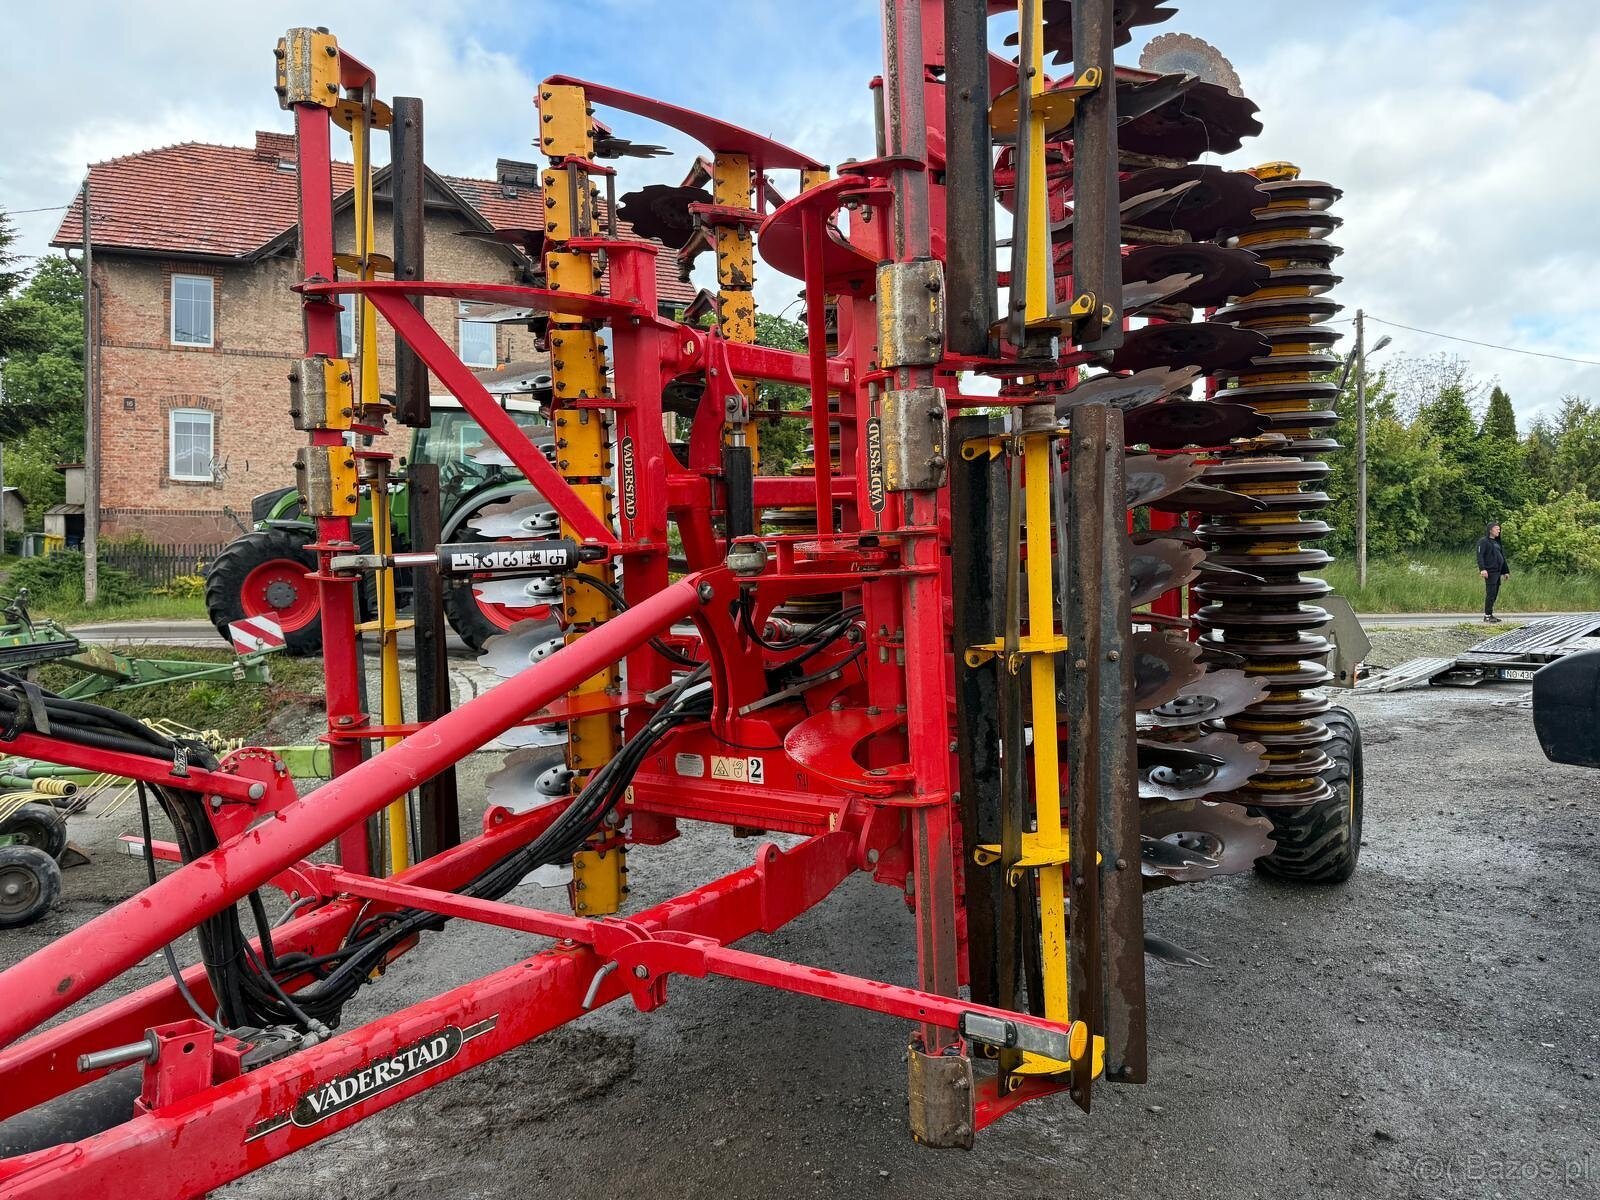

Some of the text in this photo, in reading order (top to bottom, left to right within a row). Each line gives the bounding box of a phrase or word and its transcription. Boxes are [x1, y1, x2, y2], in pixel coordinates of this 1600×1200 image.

[868, 423, 882, 506] VÄDERSTAD
[478, 558, 494, 568] 2
[502, 557, 518, 567] 3
[549, 555, 564, 565] 5
[750, 758, 762, 779] 2
[307, 1036, 449, 1114] VÄDERSTAD
